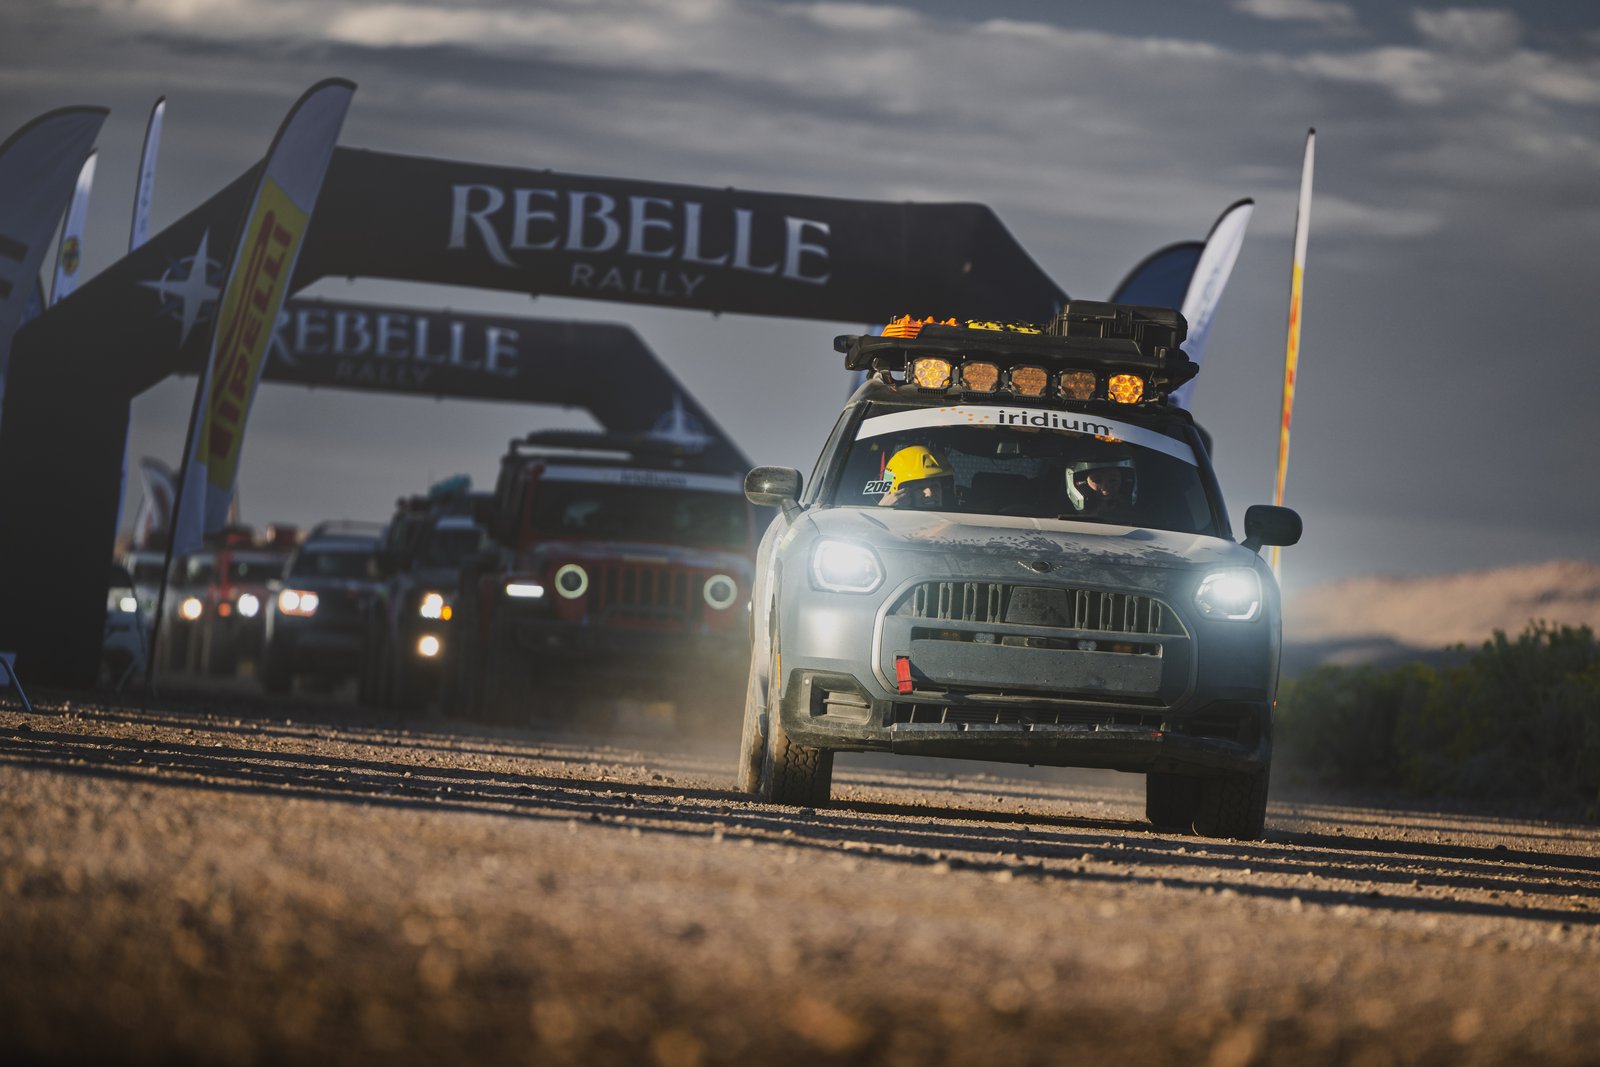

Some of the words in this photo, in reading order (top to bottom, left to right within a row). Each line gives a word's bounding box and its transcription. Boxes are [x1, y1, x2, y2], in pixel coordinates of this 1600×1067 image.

[448, 184, 832, 284] REBELLE
[570, 262, 706, 298] RALLY
[208, 209, 294, 460] PIRELLI
[999, 410, 1109, 436] iridium
[865, 481, 892, 494] 206
